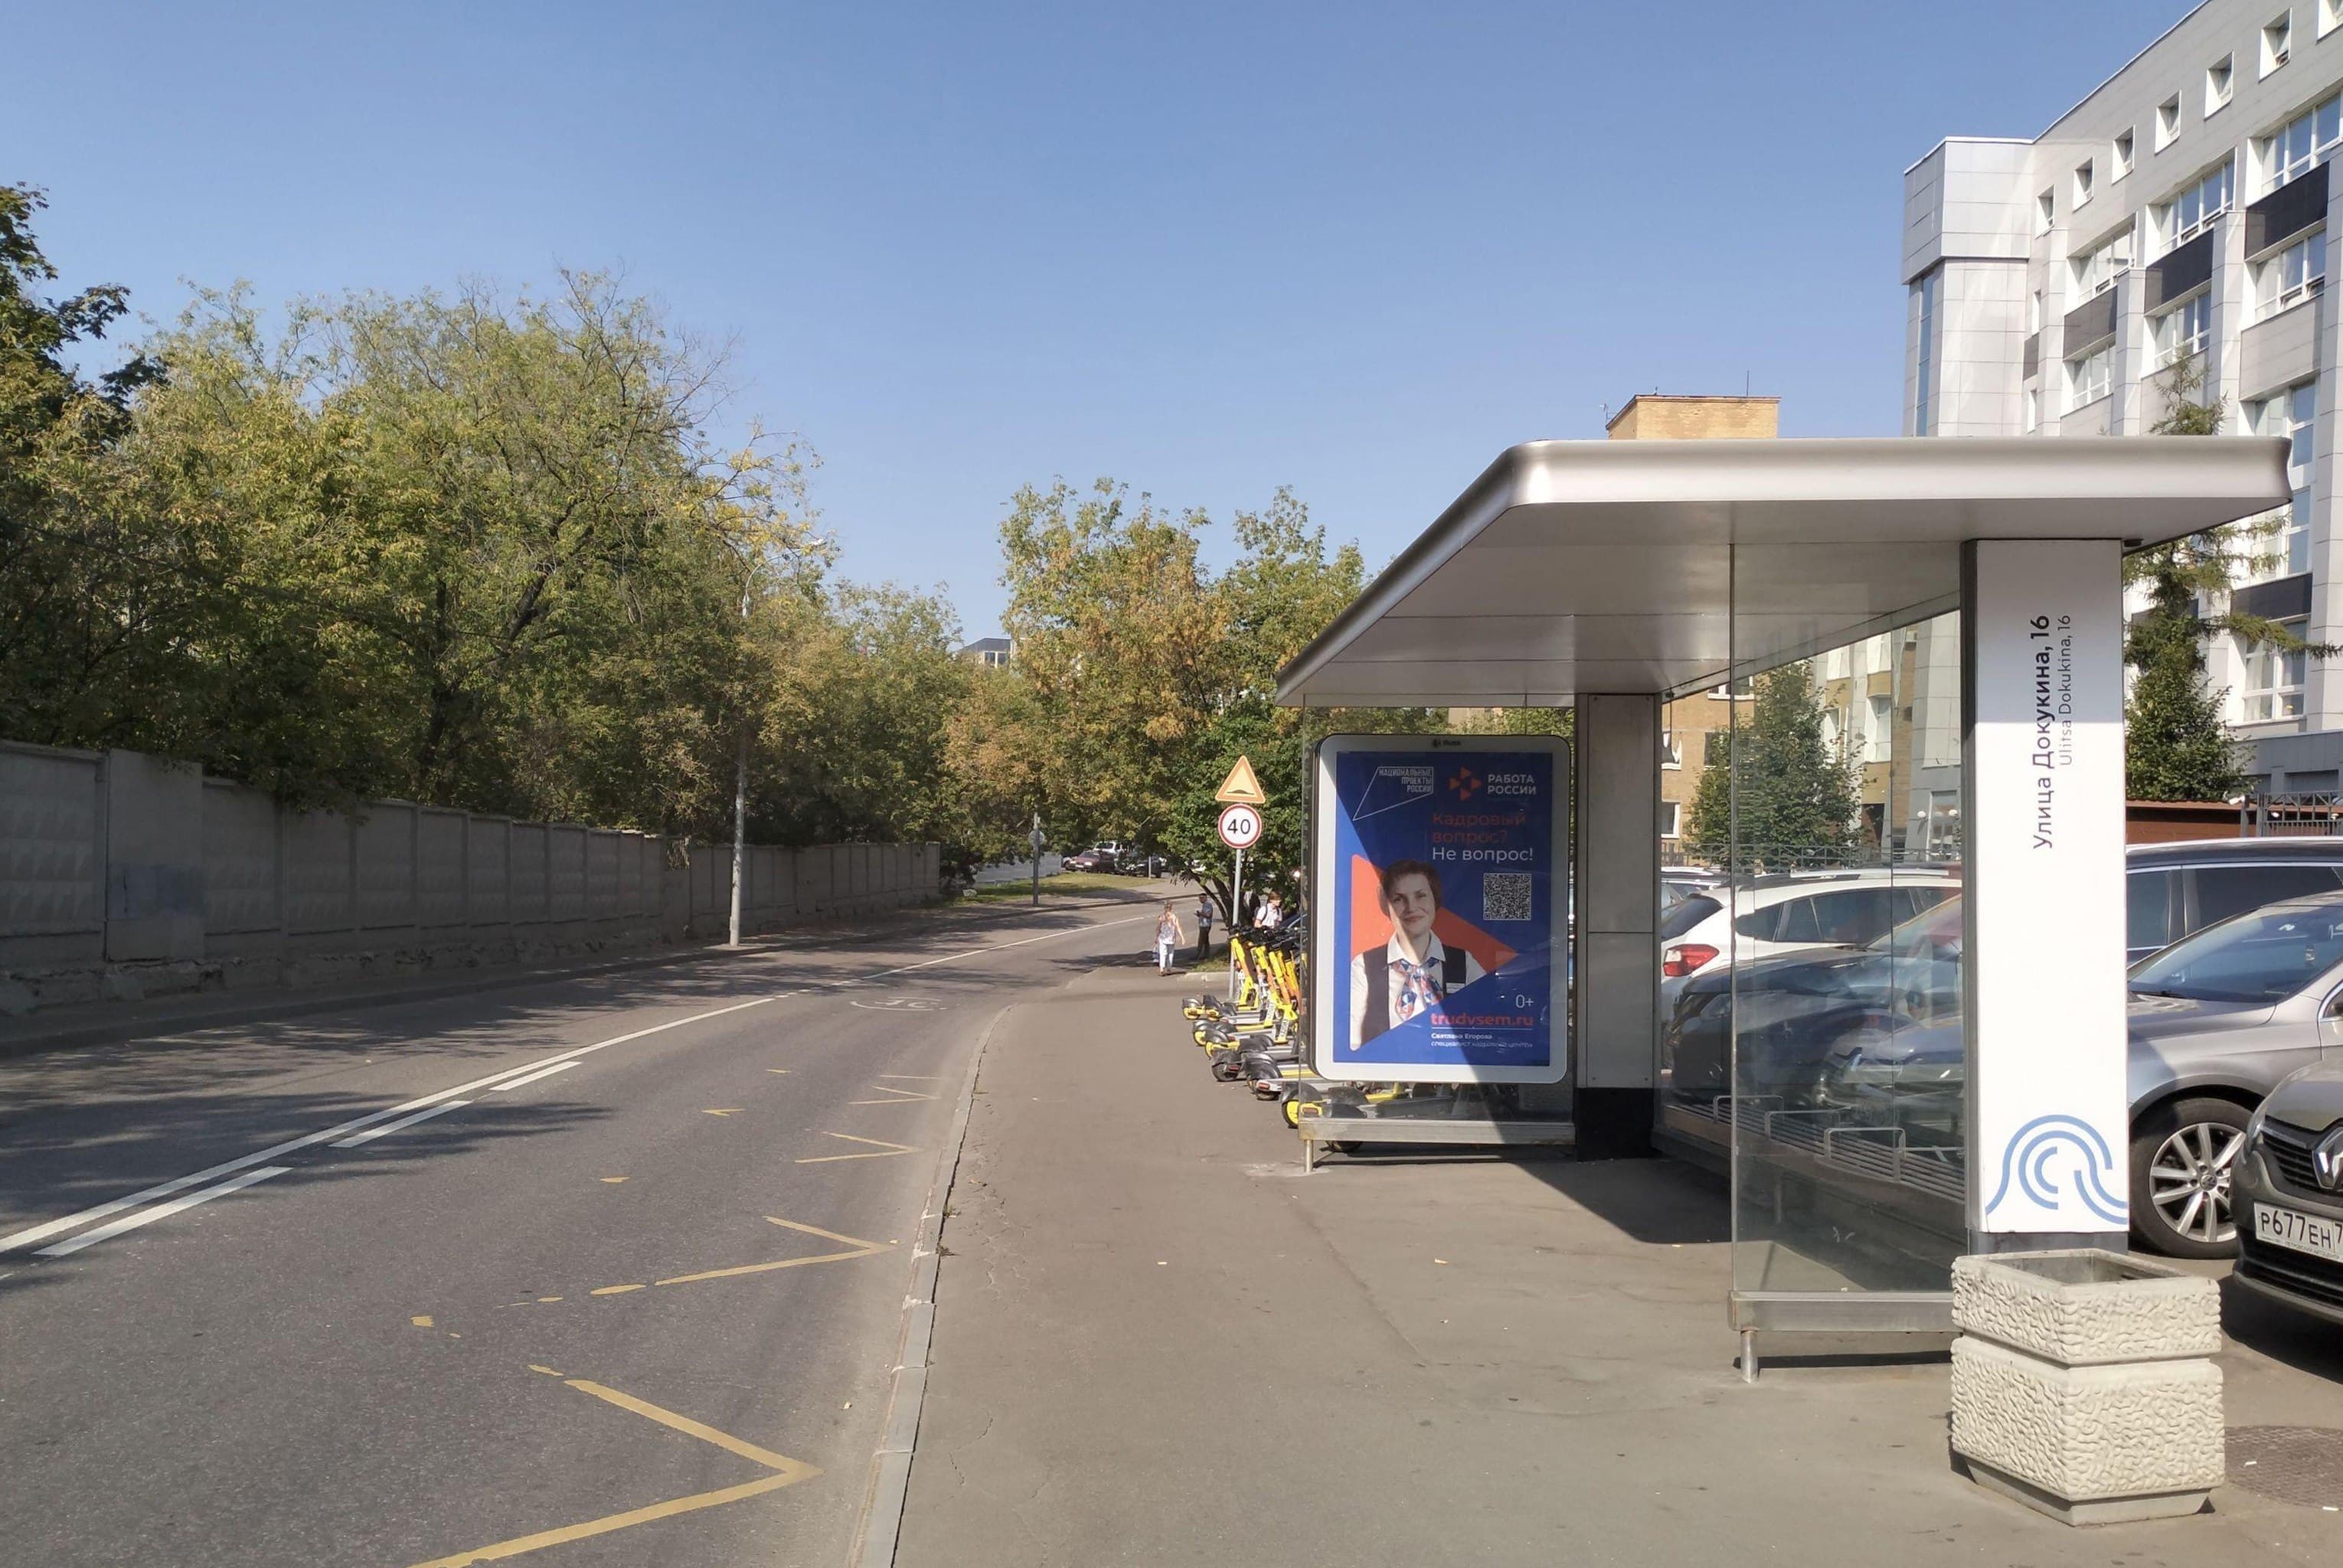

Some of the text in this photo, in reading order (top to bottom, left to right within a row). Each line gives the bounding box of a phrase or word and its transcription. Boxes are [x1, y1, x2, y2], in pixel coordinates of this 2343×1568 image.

[2057, 615, 2073, 766] Ulitsa Dokukina, 16
[2030, 615, 2055, 849] Улица Докукина, 16
[1378, 768, 1432, 776] НАЦИОНАЛЬНЫЕ
[1488, 774, 1534, 783] РАБОТА
[1401, 776, 1432, 785] ПРОЕКТЫ
[1487, 786, 1537, 795] РОССИИ
[1227, 818, 1251, 835] 40
[1433, 811, 1527, 828] Кадровый
[1433, 829, 1508, 846] вопрос?
[1433, 846, 1534, 864] Не вопрос!
[1515, 994, 1534, 1008] 0+
[1431, 1013, 1533, 1026] trudvsem.ru
